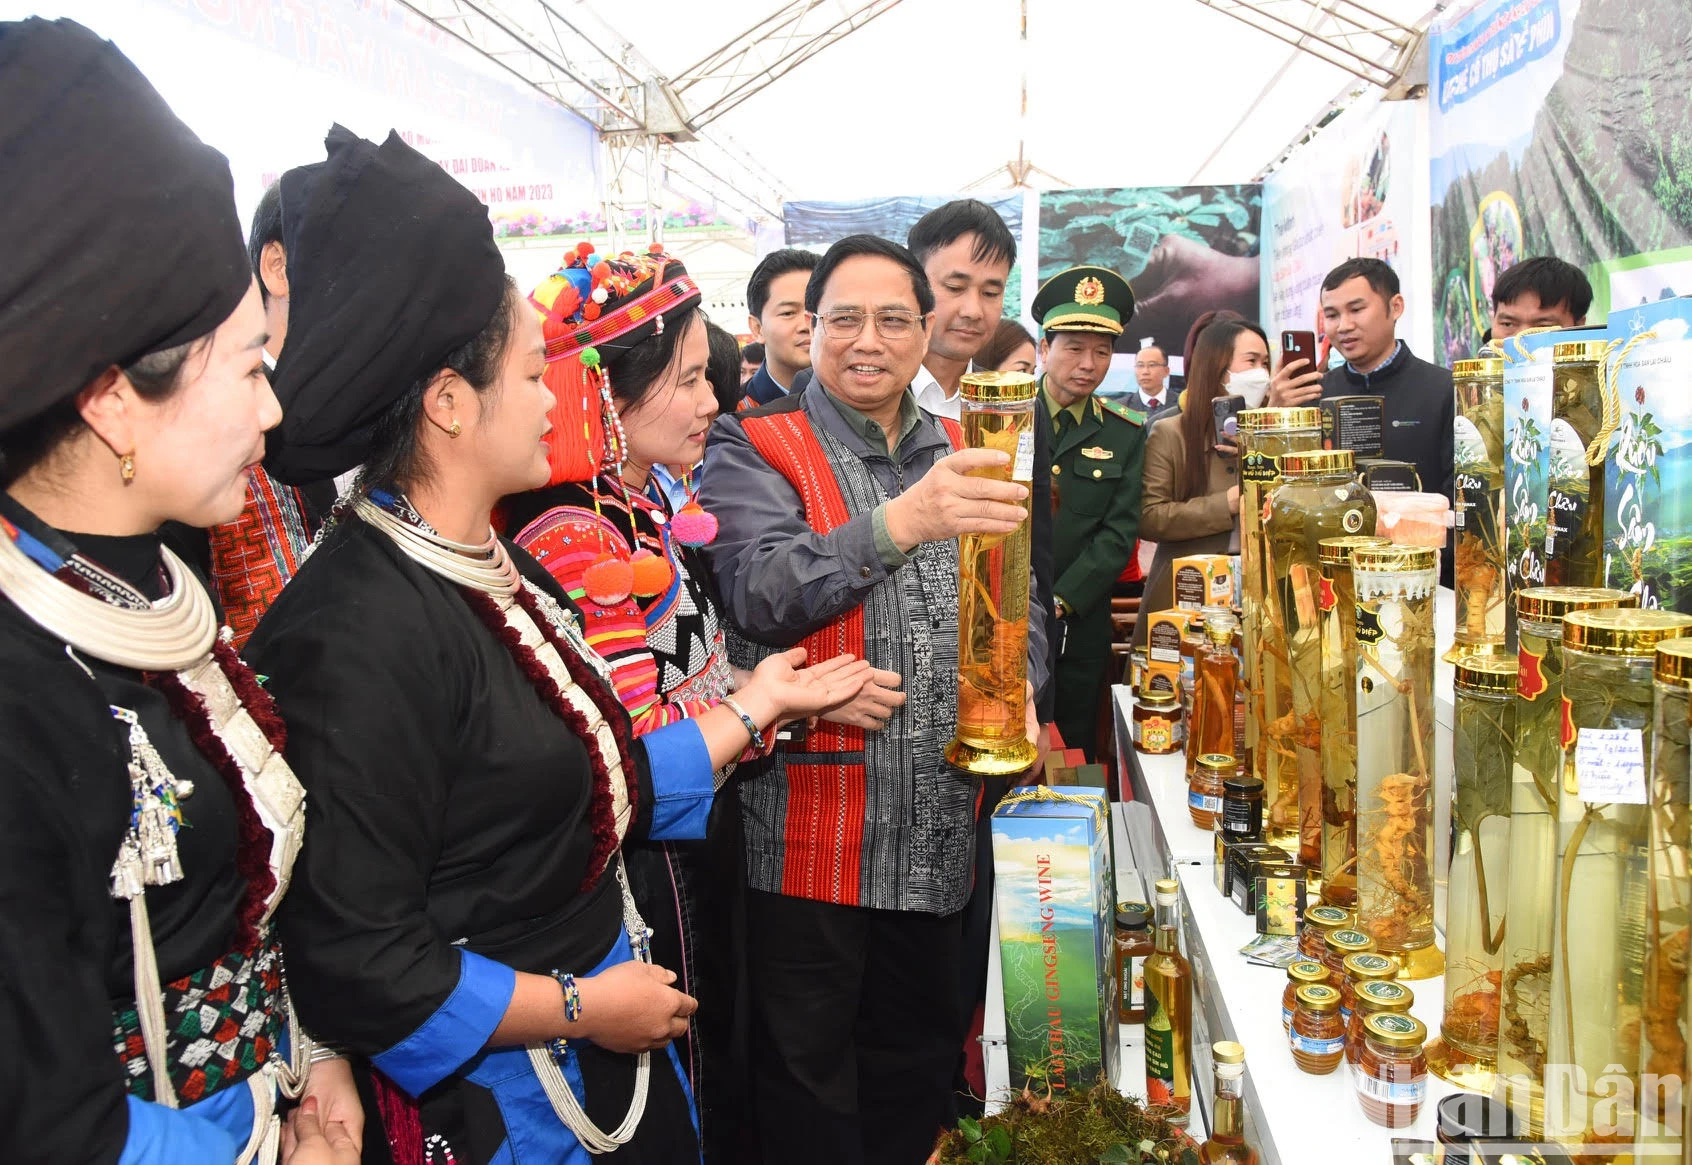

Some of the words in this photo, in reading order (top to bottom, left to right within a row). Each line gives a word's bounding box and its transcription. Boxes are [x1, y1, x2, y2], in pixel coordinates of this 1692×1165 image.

[529, 184, 553, 200] 2023
[1036, 854, 1053, 903] WINE
[1040, 907, 1061, 1001] GINGSENG
